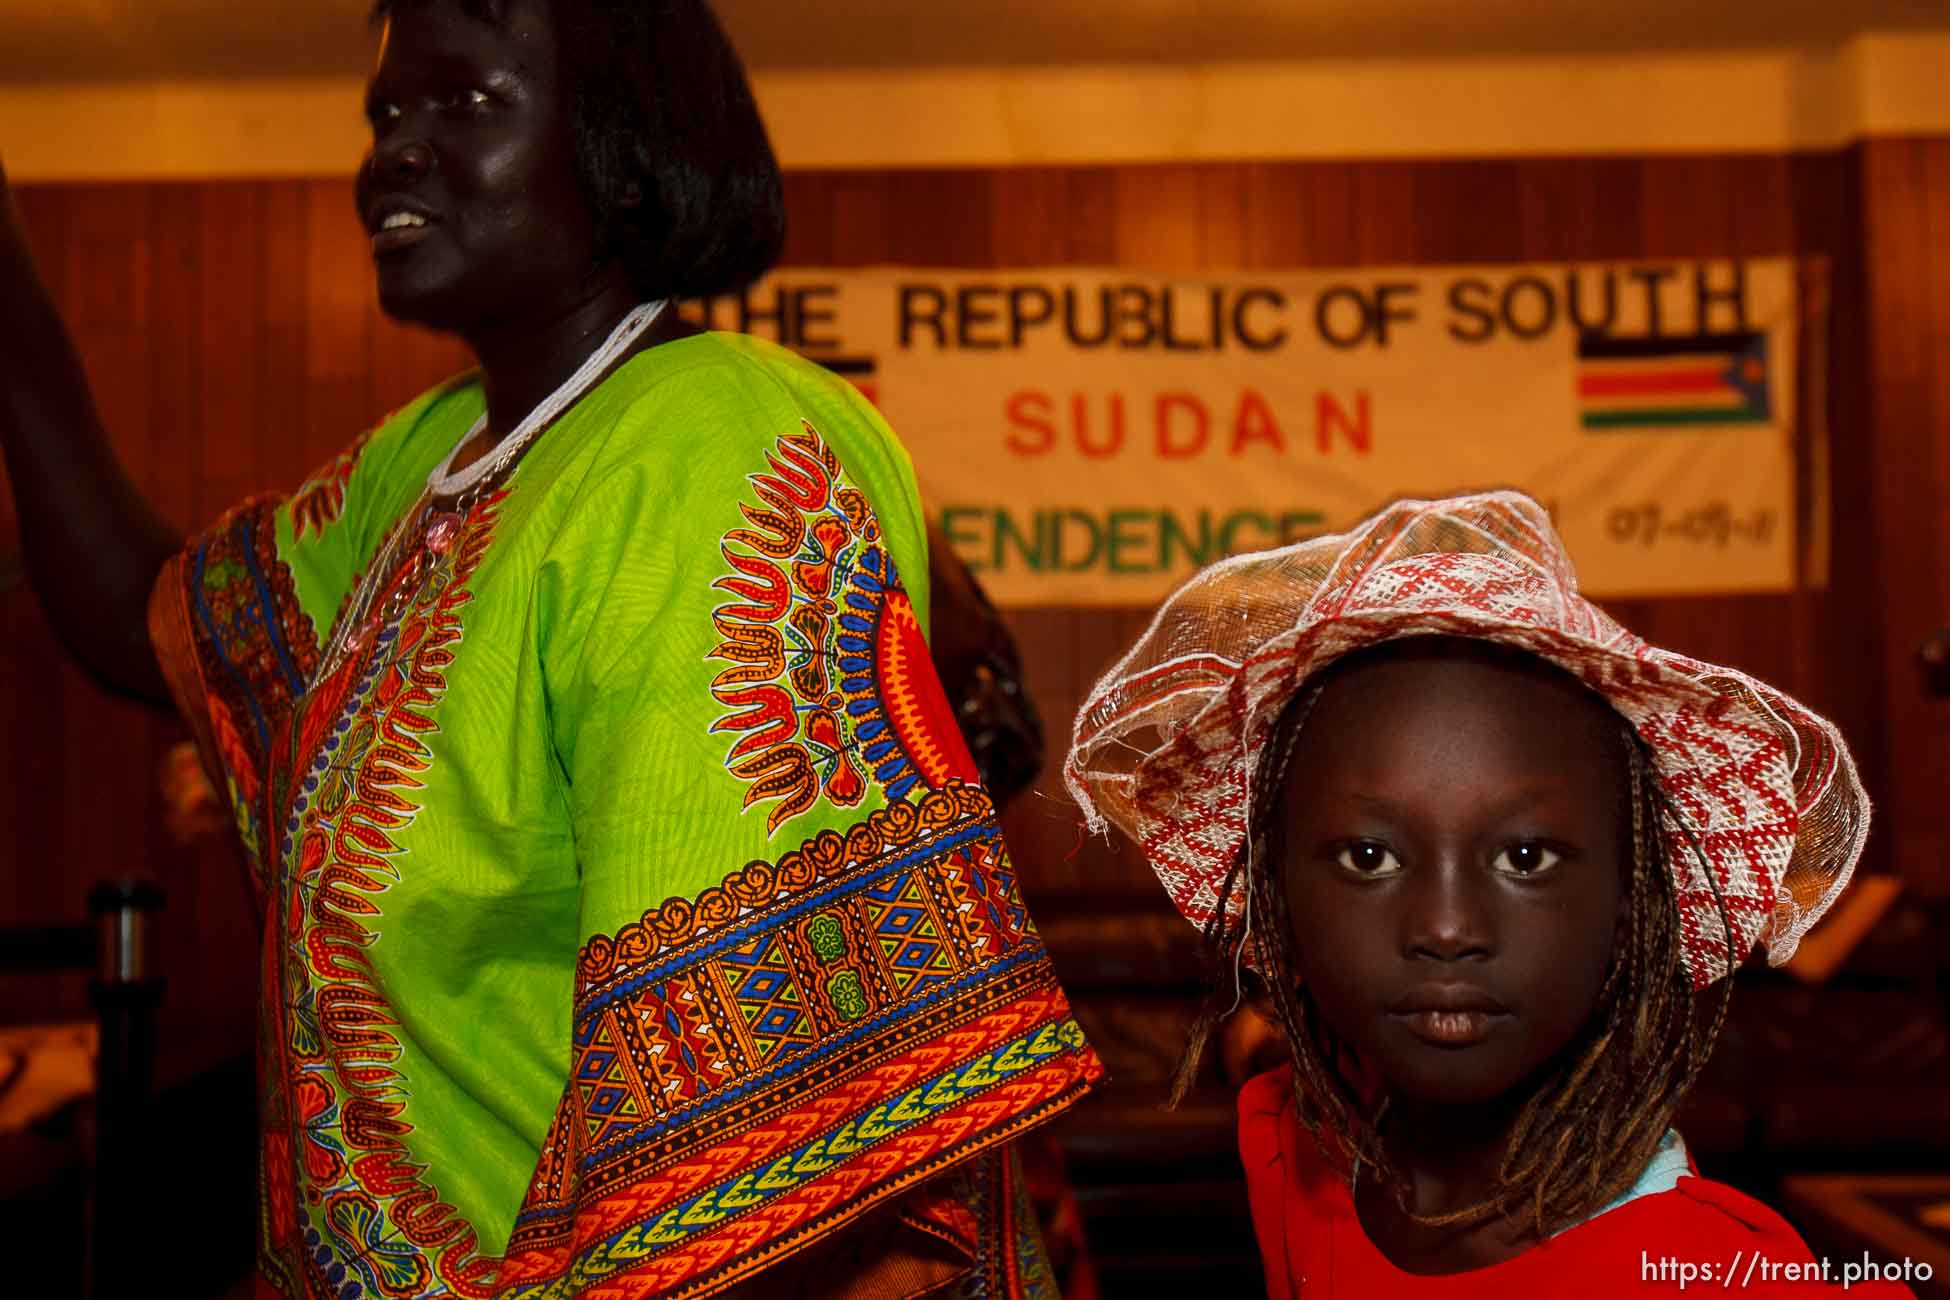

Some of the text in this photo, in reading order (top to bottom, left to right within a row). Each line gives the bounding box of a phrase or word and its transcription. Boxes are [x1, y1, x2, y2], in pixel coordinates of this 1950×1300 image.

[897, 282, 1289, 352] REPUBLIC
[1315, 283, 1420, 349] OF
[1446, 263, 1747, 343] SOUTH
[1005, 389, 1373, 459] SUDAN
